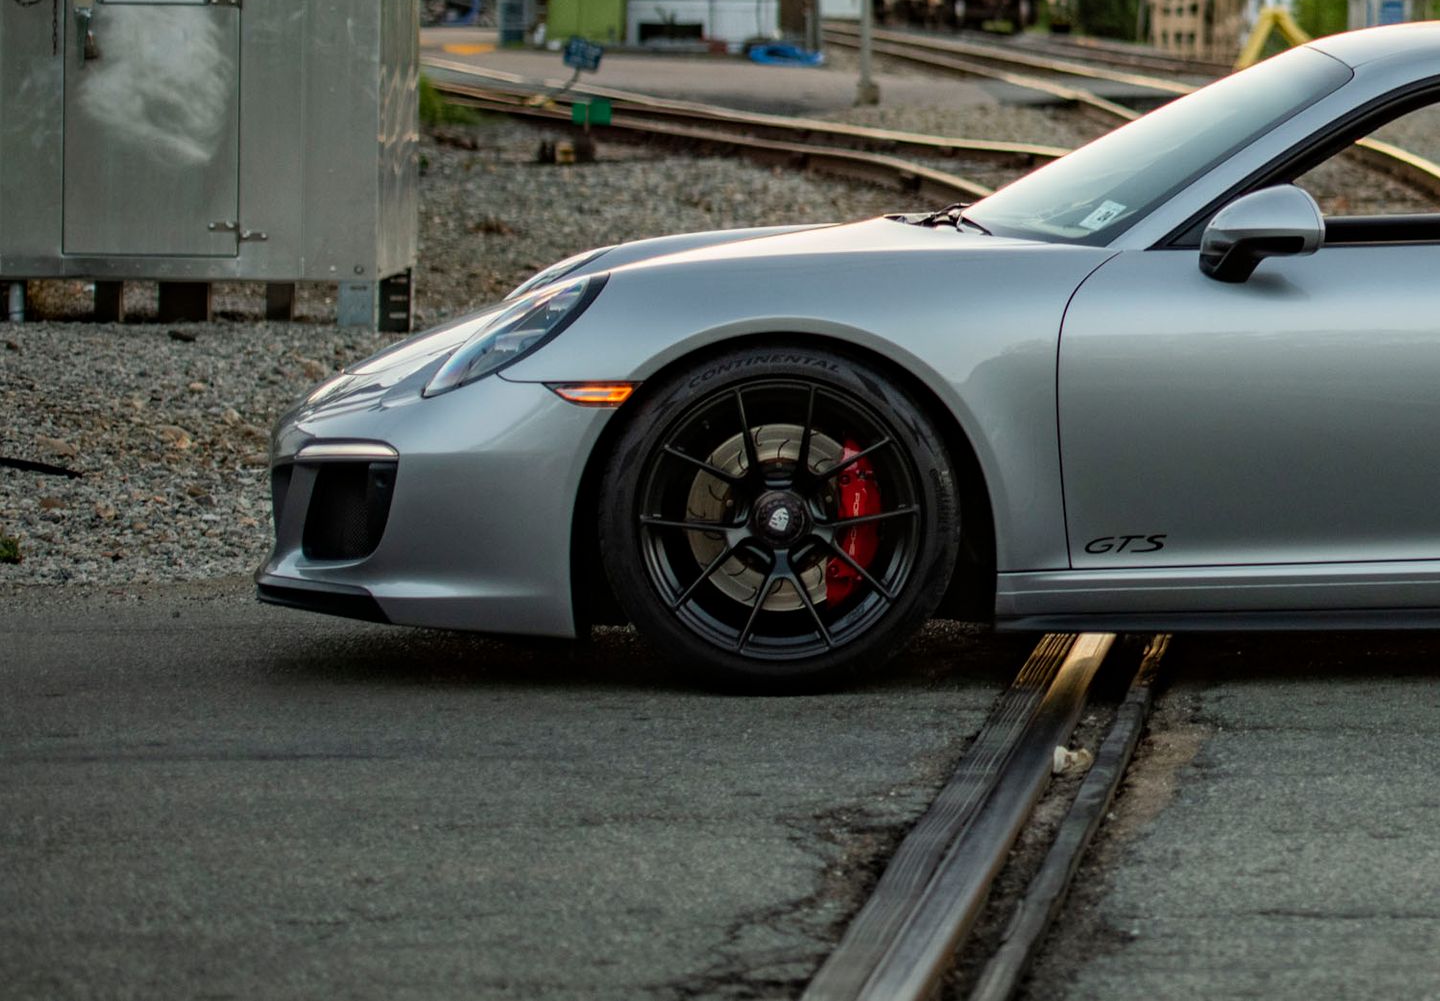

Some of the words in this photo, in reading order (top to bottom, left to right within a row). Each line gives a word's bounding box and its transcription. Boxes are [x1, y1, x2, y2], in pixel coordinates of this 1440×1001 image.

[688, 354, 840, 389] CONTINENTAL
[848, 492, 862, 556] POCHE
[1084, 534, 1168, 554] GTS
